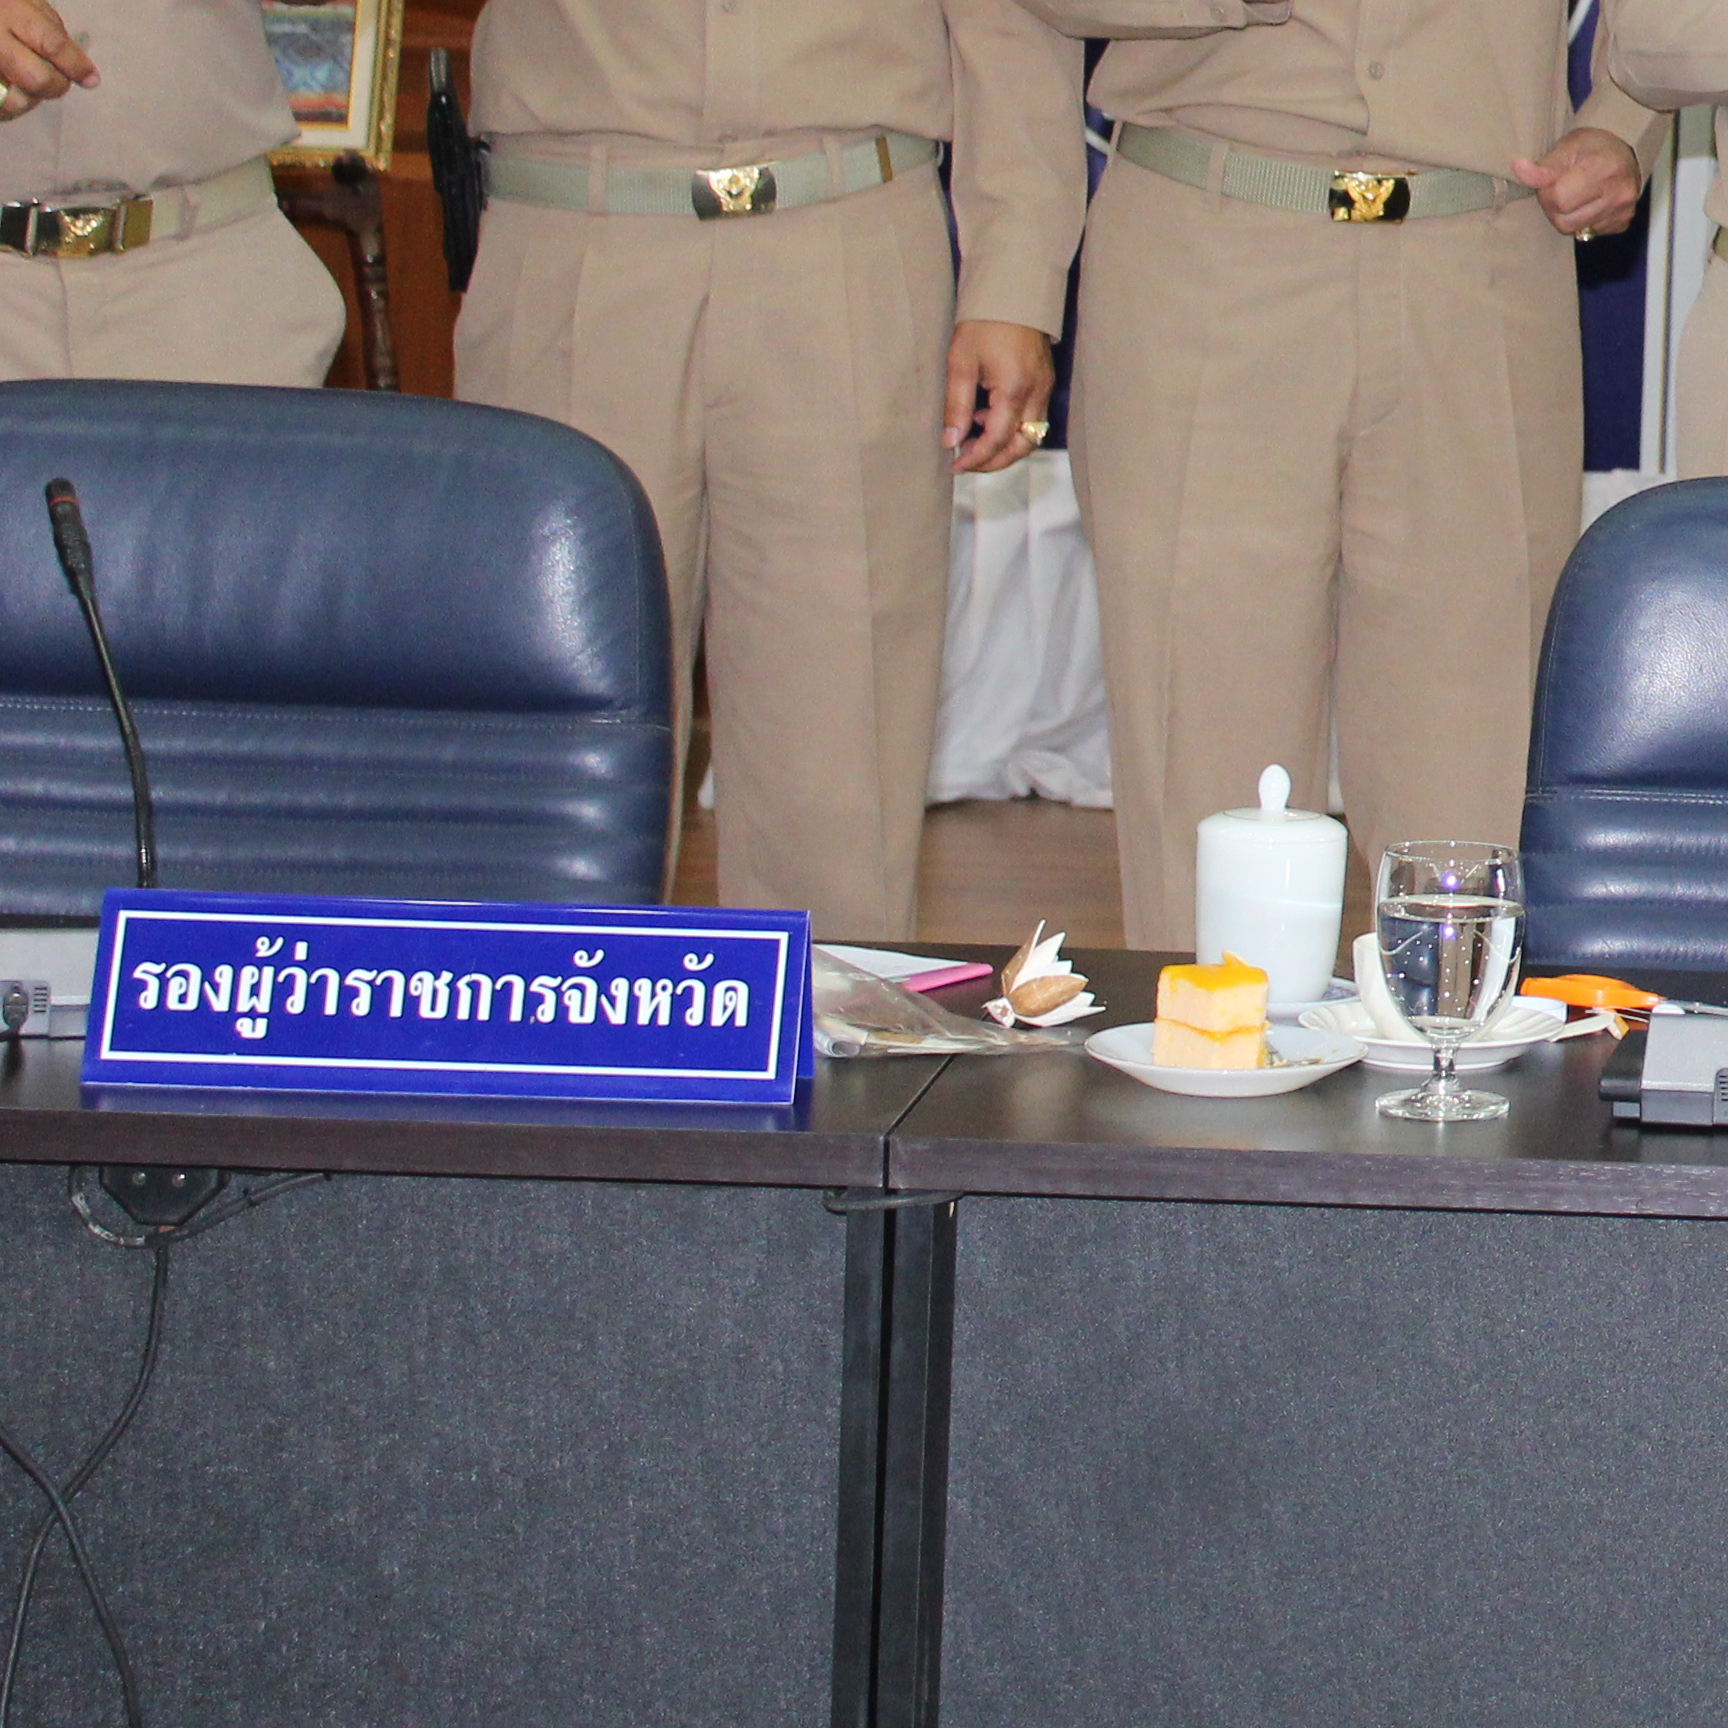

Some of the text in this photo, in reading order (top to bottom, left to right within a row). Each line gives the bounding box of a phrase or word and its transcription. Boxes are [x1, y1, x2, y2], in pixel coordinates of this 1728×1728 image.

[132, 936, 749, 1039] รองผู้ว่าราชการจังหวัด
